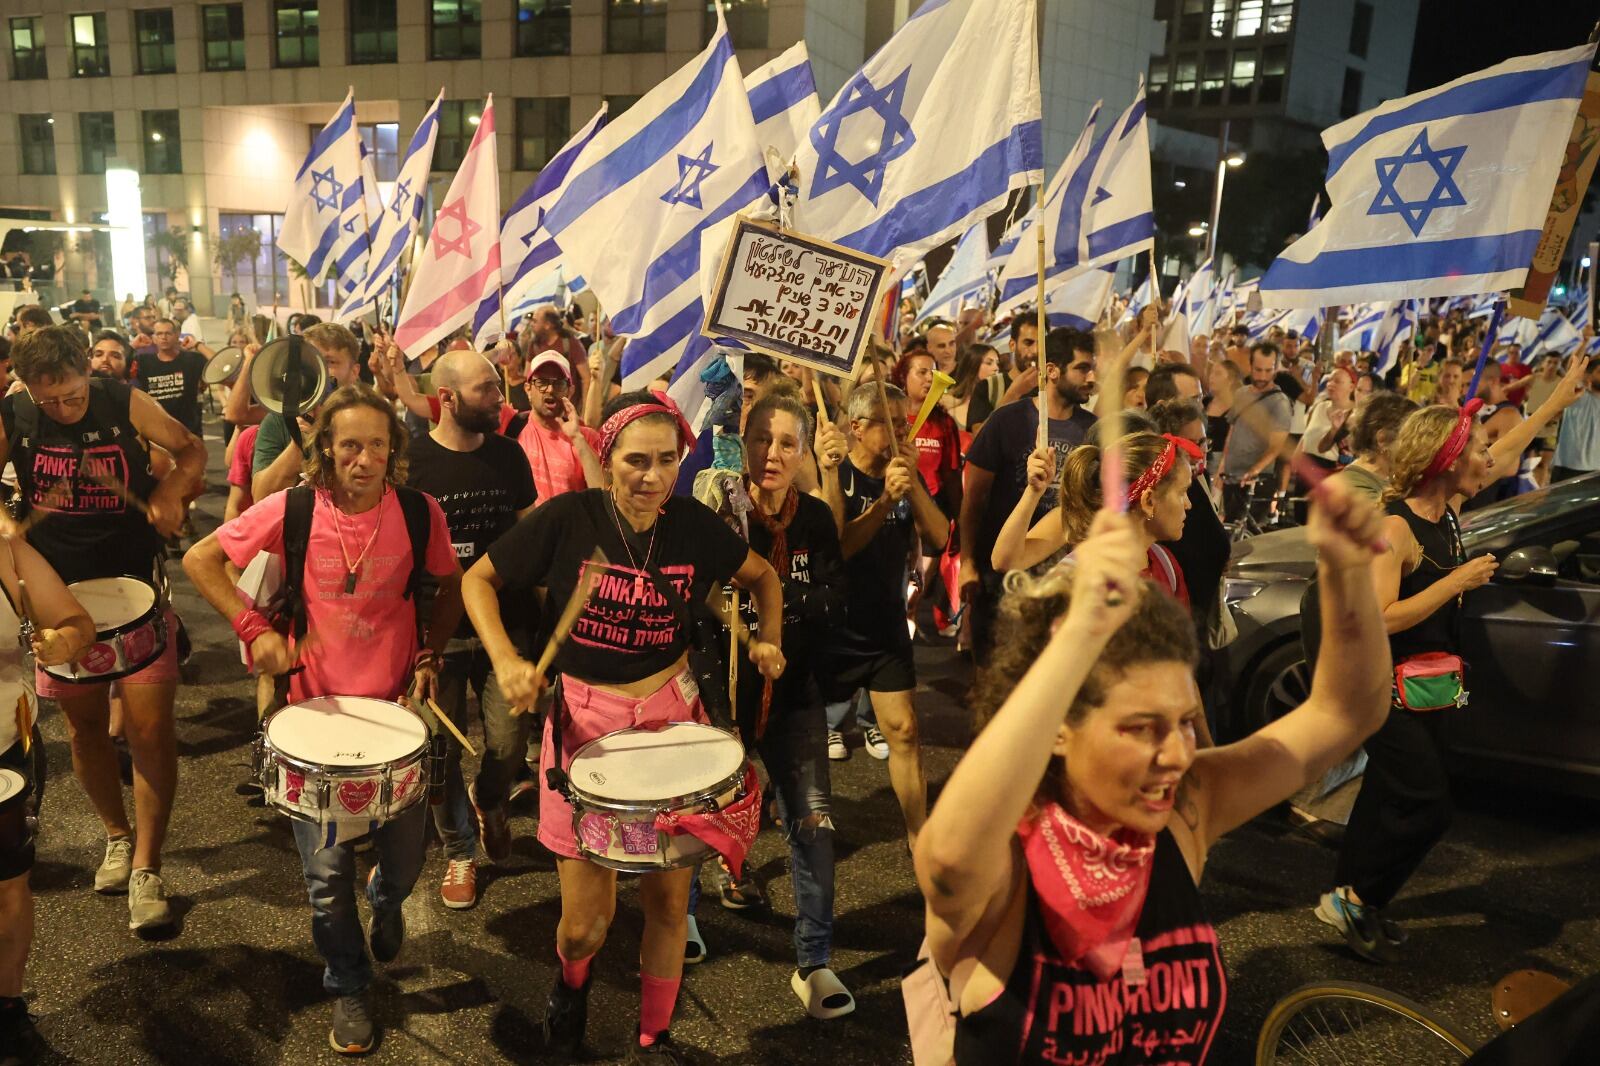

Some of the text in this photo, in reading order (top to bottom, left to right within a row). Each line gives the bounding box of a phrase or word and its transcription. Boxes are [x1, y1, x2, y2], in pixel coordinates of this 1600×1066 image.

[809, 277, 845, 298] אתם
[850, 290, 865, 302] כי
[733, 299, 775, 316] את
[577, 617, 629, 645] הורודה
